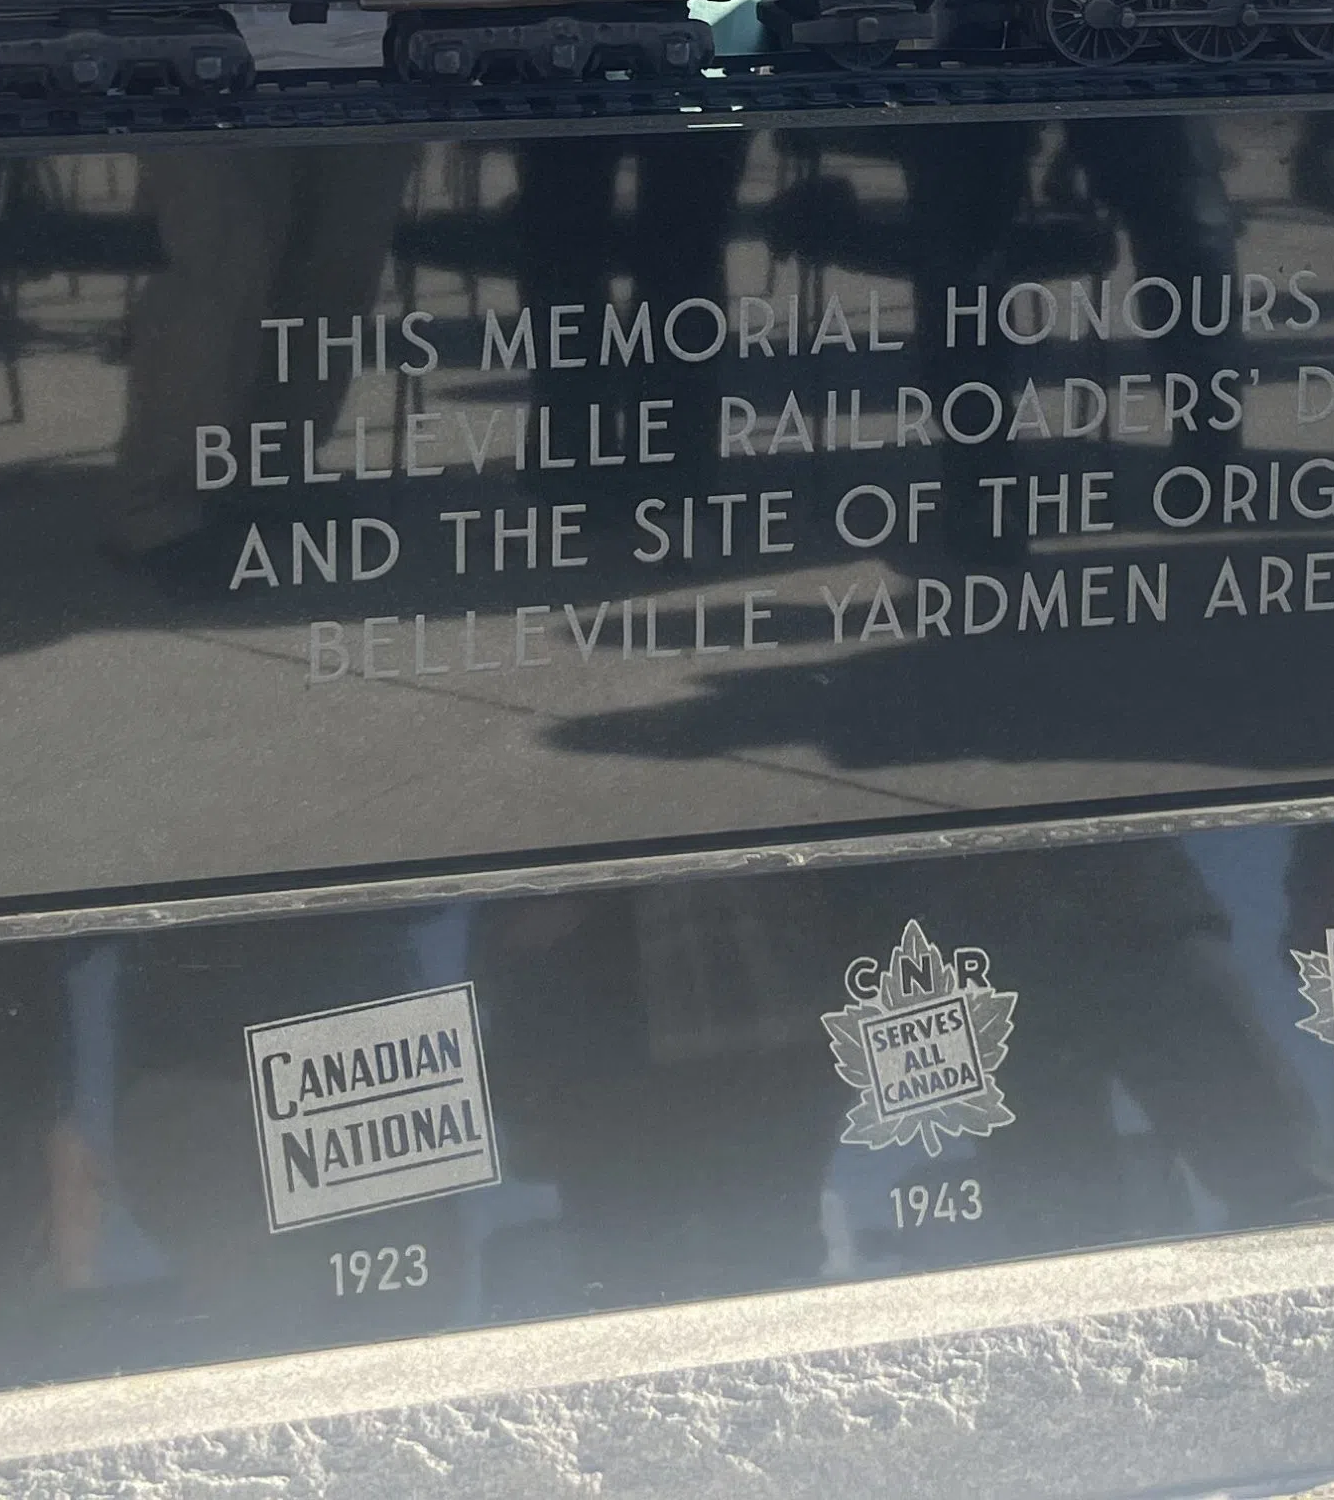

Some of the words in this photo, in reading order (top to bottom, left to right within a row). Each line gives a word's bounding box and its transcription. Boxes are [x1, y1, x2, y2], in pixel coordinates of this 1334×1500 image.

[260, 311, 440, 383] THIS
[480, 290, 906, 371] MEMORIAL
[946, 271, 1321, 348] HONOURS
[195, 400, 676, 491] BELLEVILLE
[720, 368, 1260, 458] RAILROADERS'
[229, 518, 401, 590] AND
[439, 503, 589, 575] THE
[632, 490, 795, 563] SITE
[835, 481, 942, 548] OF
[978, 471, 1115, 538] THE
[305, 589, 779, 686] BELLEVILLE
[819, 562, 1168, 644] YARDMEN
[262, 1027, 462, 1121] CANADIAN
[871, 1008, 963, 1053] SERVES
[904, 1043, 946, 1074] ALL
[883, 1062, 977, 1104] CANADA
[281, 1098, 482, 1194] NATIONAL
[889, 1179, 983, 1228] 1943
[329, 1243, 430, 1297] 1923
